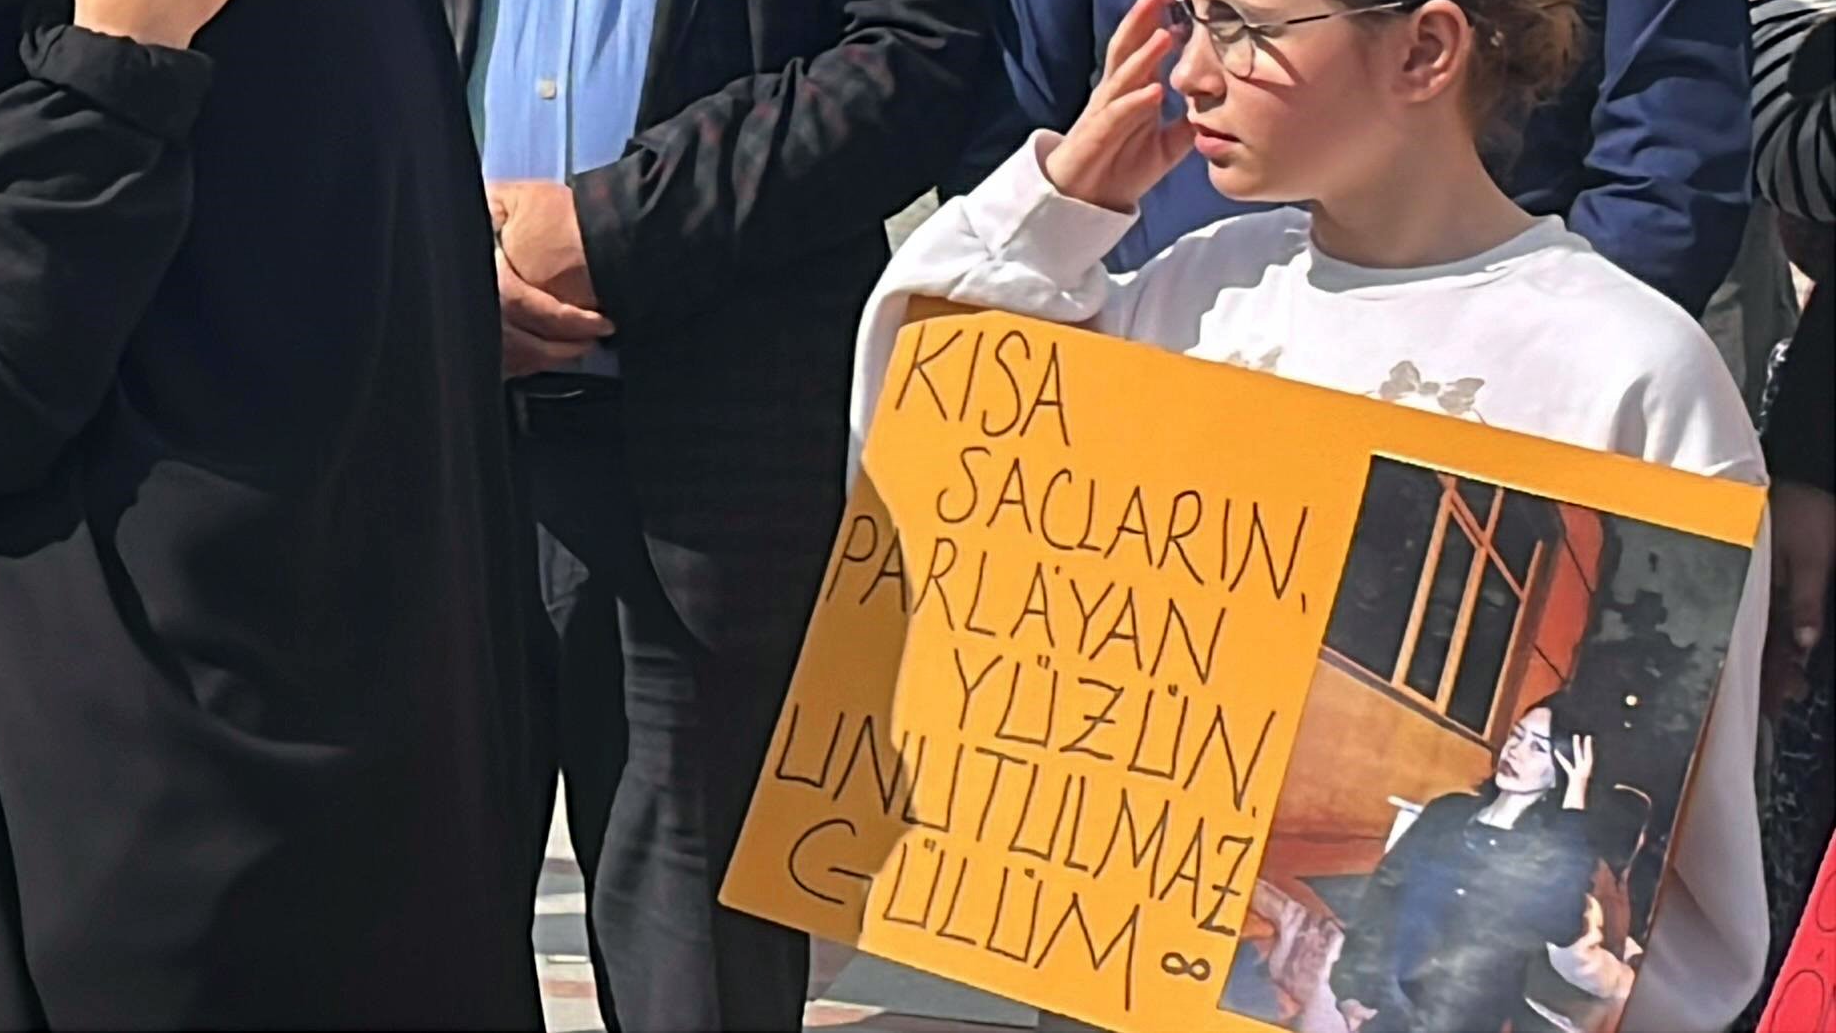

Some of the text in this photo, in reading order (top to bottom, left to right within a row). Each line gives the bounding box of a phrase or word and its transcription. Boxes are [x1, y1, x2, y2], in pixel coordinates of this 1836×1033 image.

[895, 324, 1070, 447] KISA
[775, 703, 1255, 937] UNUTULMAZ
[788, 818, 1141, 1013] GÜLÜM
